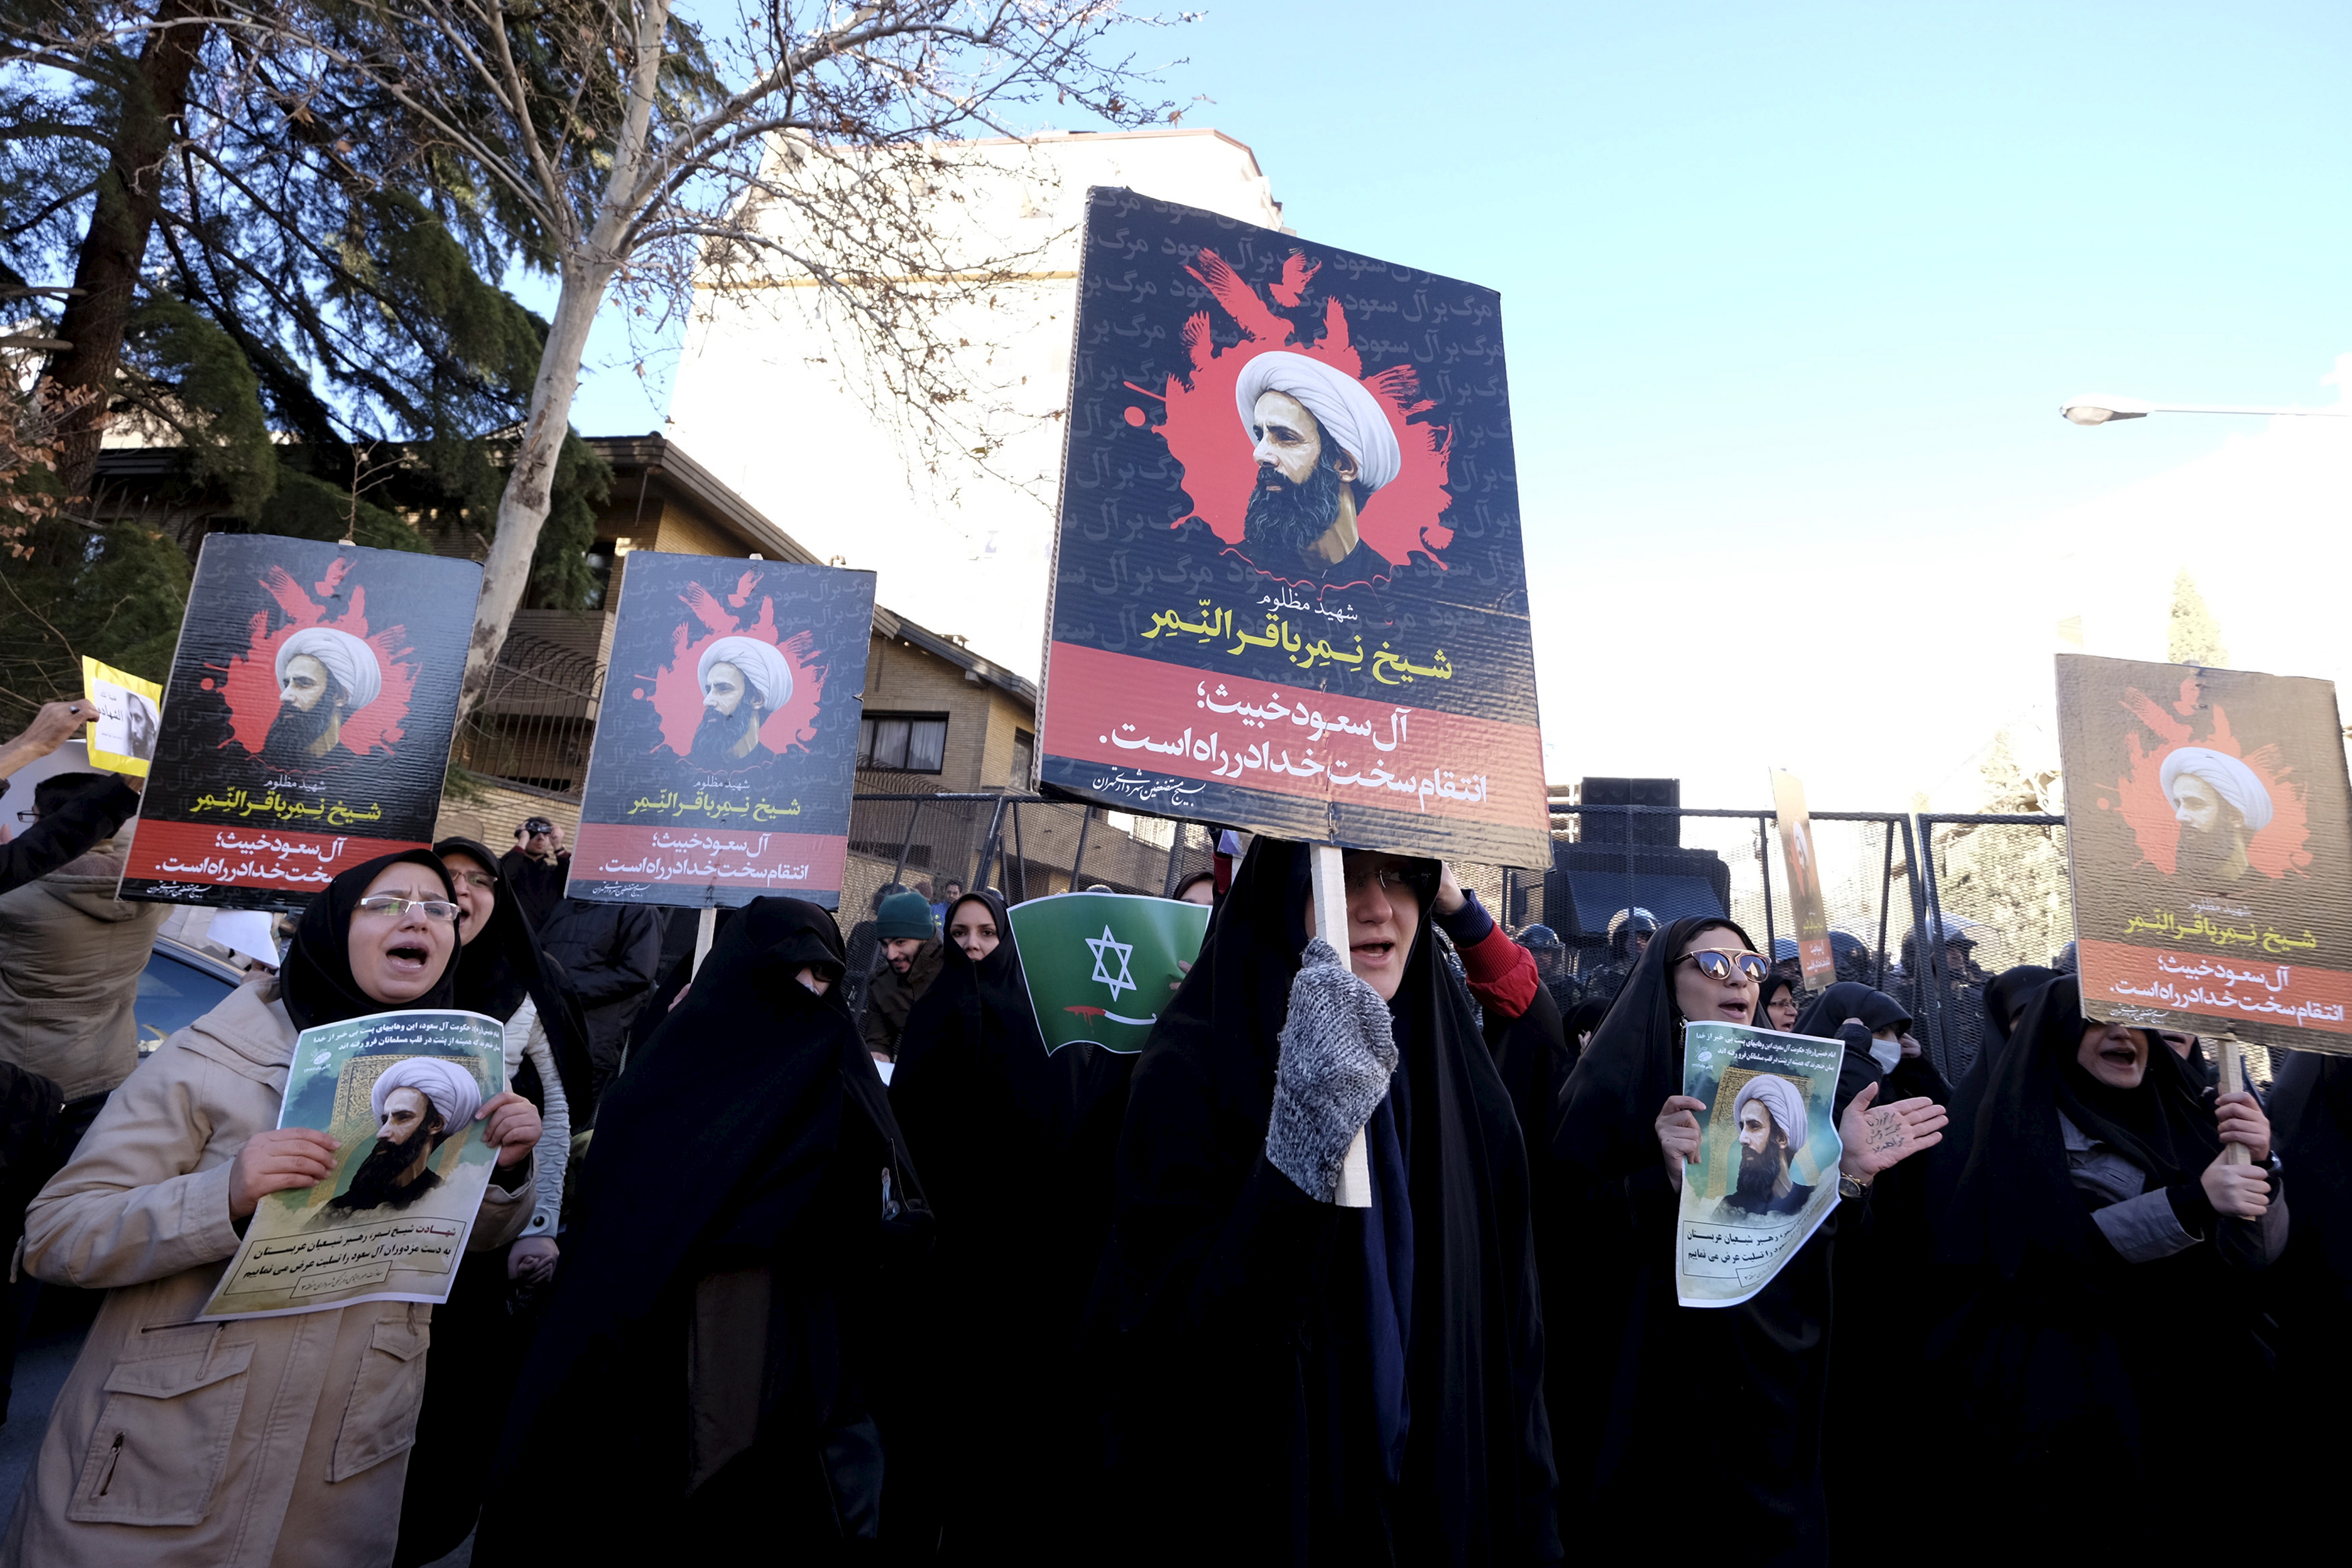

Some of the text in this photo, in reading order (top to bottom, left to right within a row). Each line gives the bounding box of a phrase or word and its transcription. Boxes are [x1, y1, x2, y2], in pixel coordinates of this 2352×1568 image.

[1106, 270, 1157, 303] مرگ
[1345, 288, 1492, 325] مرگ بر آل سعود
[1087, 313, 1165, 348] مرگ بر
[1355, 335, 1409, 362] سعود
[1413, 329, 1440, 363] آل
[1443, 341, 1460, 364] بر
[1092, 549, 1213, 596] مرگ بر آل
[1257, 587, 1358, 623] شهید مظلوم
[1227, 612, 1300, 662] باقر
[1372, 641, 1452, 684] شیخ
[1292, 702, 1372, 741] سعود
[1373, 708, 1411, 751] آل
[1099, 723, 1486, 812] انتقام سخت خدا در راه است.
[263, 775, 326, 792] شهید مظلوم
[693, 775, 750, 791] شهید مظلوم
[1093, 767, 1206, 807] بسیج مستضعفین شهرداری تهران
[240, 790, 286, 817] باقر
[328, 800, 381, 825] شیخ
[672, 791, 714, 816] باقر
[753, 798, 800, 822] شیخ
[270, 838, 319, 859] سعود
[318, 838, 347, 862] آل
[702, 836, 747, 856] سعود
[746, 833, 772, 857] آل
[208, 858, 230, 881] راه
[225, 863, 250, 881] در
[248, 861, 285, 879] خدا
[646, 858, 664, 880] راه
[662, 861, 682, 880] در
[683, 859, 716, 875] خدا
[718, 861, 767, 879] سخت
[767, 863, 809, 887] انتقام
[2187, 898, 2251, 916] شهید مظلوم
[2173, 914, 2217, 942] باقر
[2262, 927, 2316, 953] شیخ
[2213, 964, 2266, 986] سعود
[2266, 966, 2290, 992] آل
[2159, 983, 2180, 1007] راه
[2199, 987, 2237, 1006] خدا
[2238, 996, 2296, 1016] سخت
[2296, 1001, 2344, 1026] انتقام
[406, 1022, 417, 1031] این
[439, 1022, 449, 1031] آل
[450, 1024, 470, 1032] حکومت
[343, 1234, 367, 1247] رهبر
[391, 1225, 414, 1237] شیخ
[416, 1225, 456, 1237] شهادت
[1687, 1229, 1778, 1246] رهبر شیعیان عربستان
[254, 1243, 306, 1260] عربستان
[307, 1236, 343, 1252] شیعیان
[1688, 1249, 1706, 1260] نماییم
[243, 1244, 451, 1280] به دست مزدوران آل سعود را تسلیت عرض می نماییم
[1708, 1254, 1718, 1262] می
[1721, 1252, 1740, 1263] عرض
[1741, 1251, 1764, 1262] تسلیت
